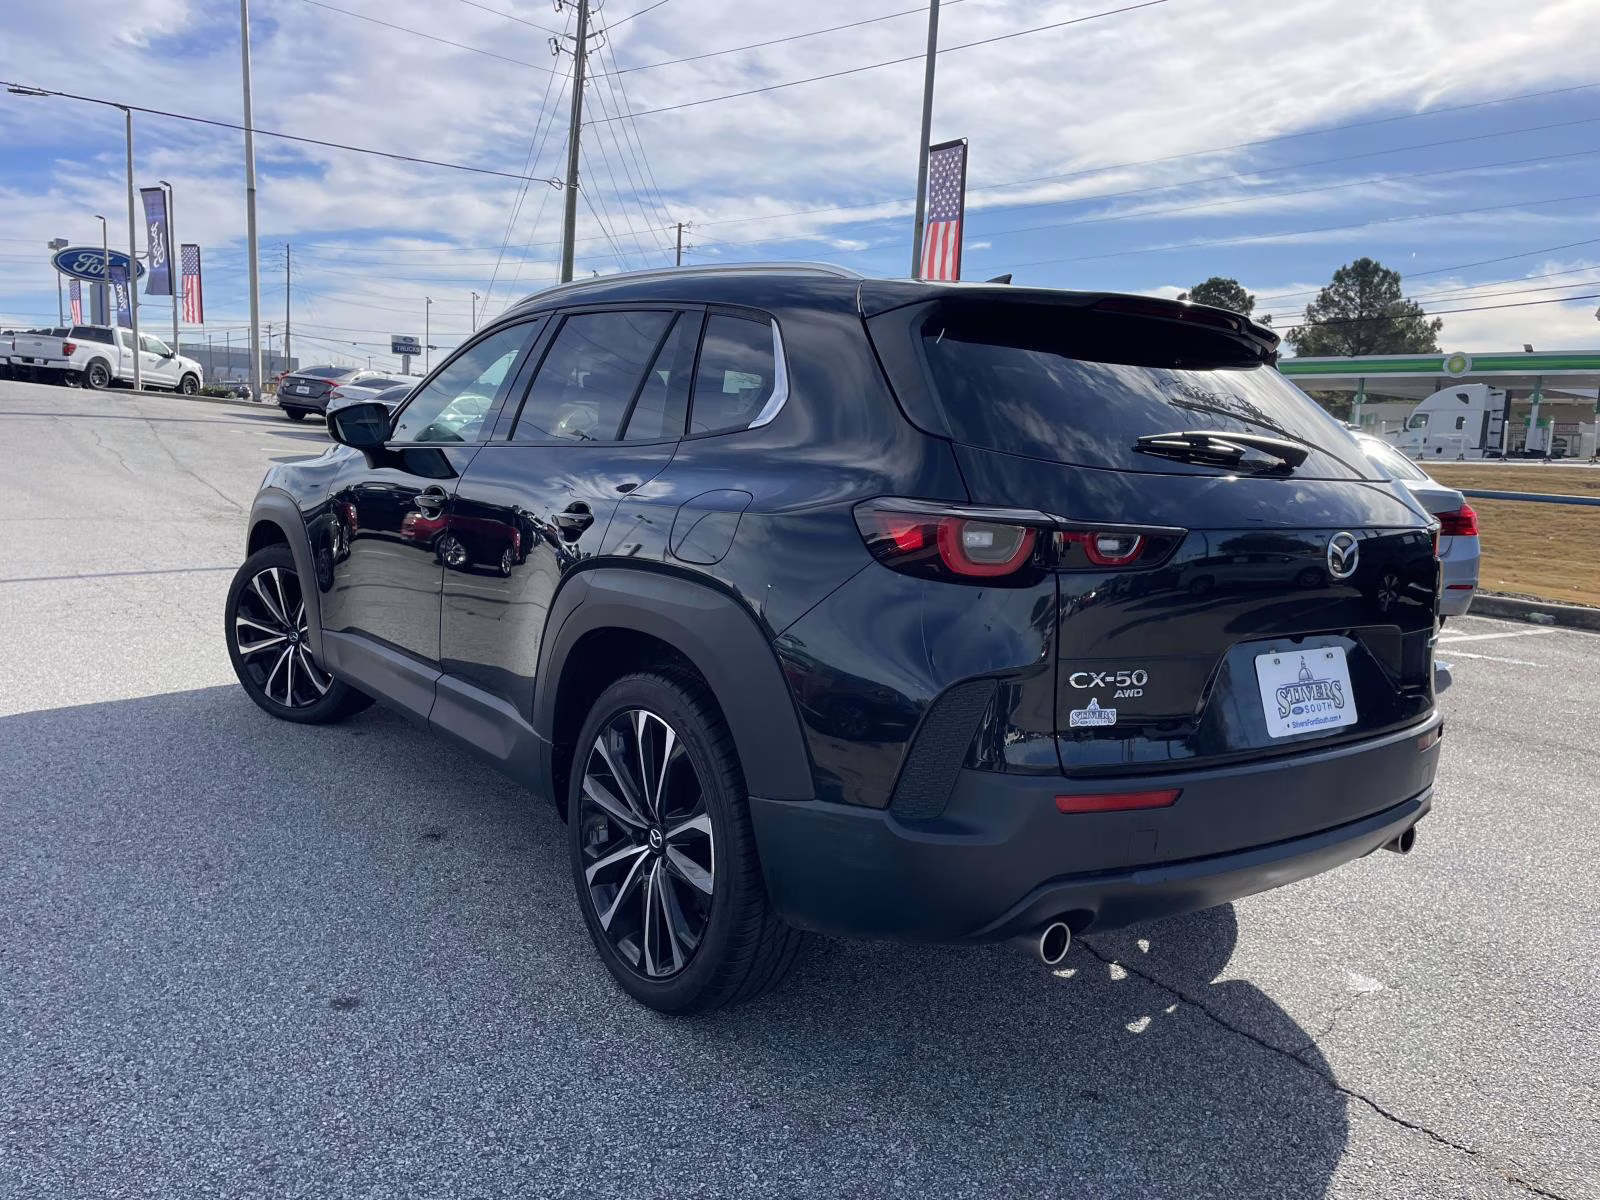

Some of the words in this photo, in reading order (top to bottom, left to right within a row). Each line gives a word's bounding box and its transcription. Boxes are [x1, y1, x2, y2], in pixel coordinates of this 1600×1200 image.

[397, 345, 420, 354] TRUCKS
[1069, 669, 1148, 689] CX-50
[1113, 688, 1144, 699] AWD
[1276, 680, 1345, 719] STIVERS
[1304, 701, 1333, 714] SOUTH
[1071, 710, 1116, 726] STIVERS
